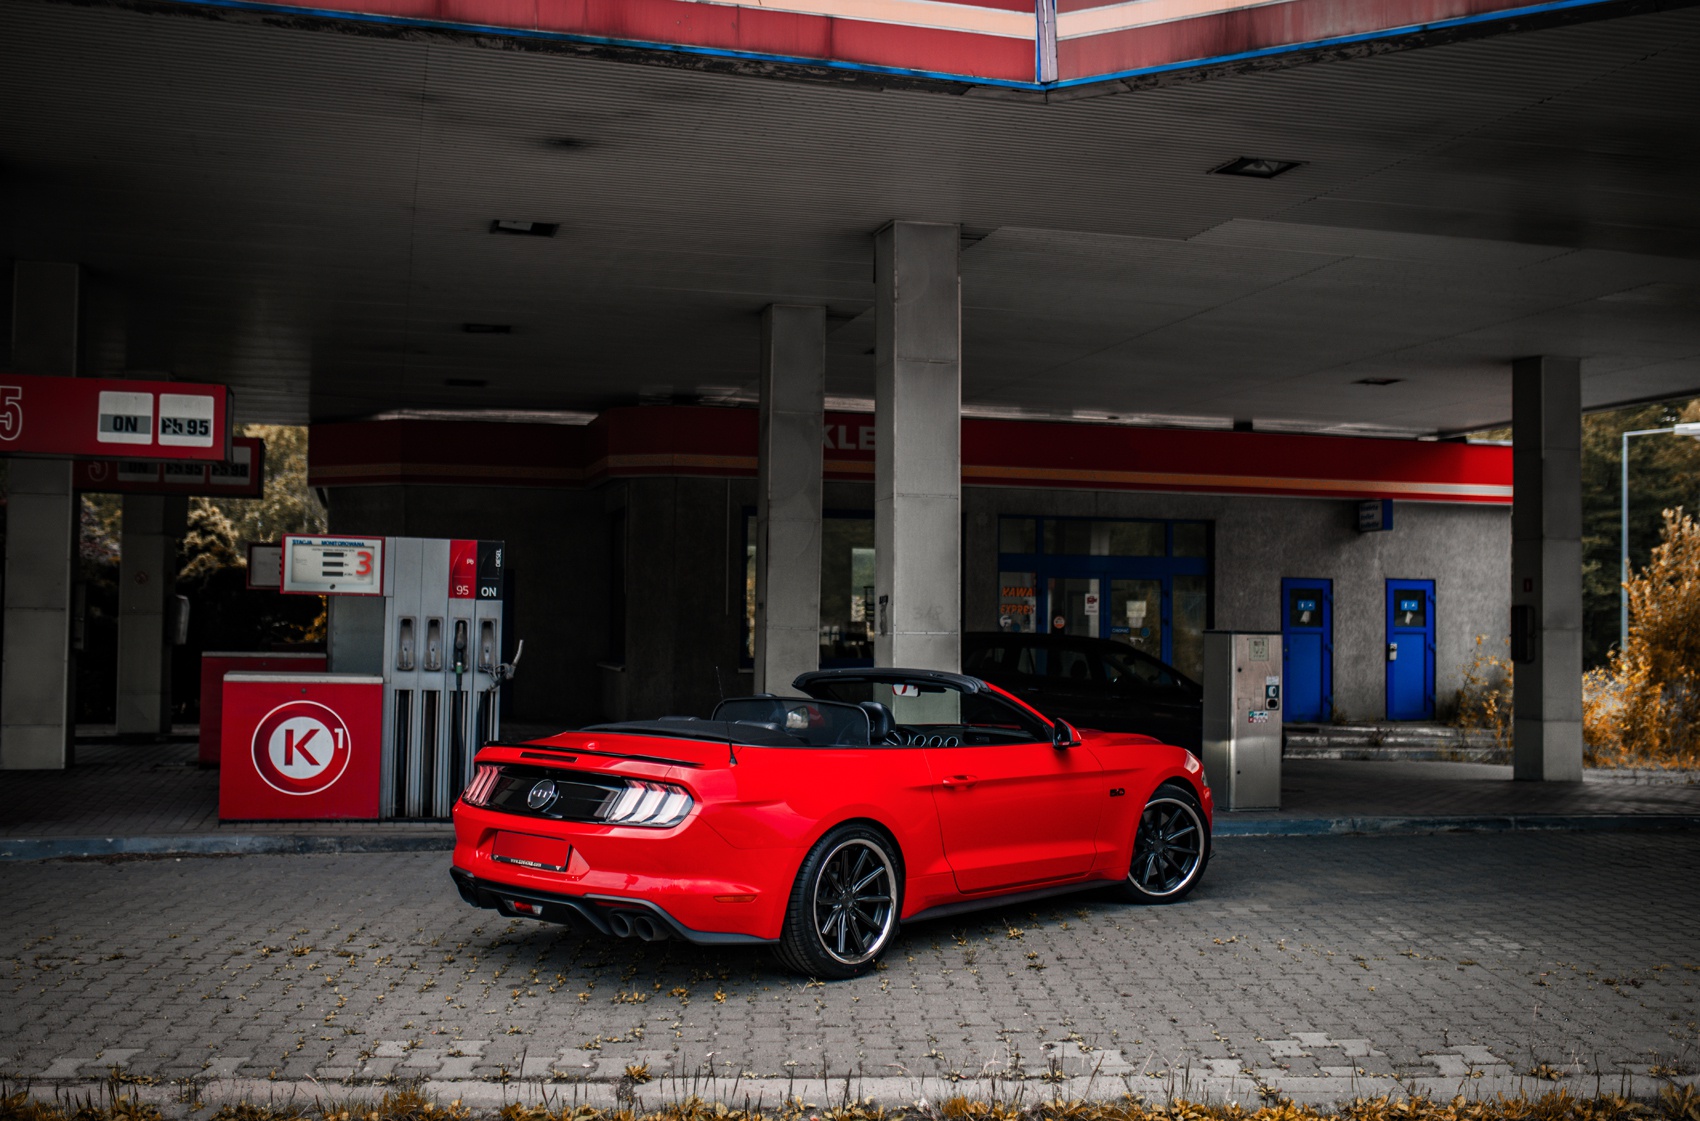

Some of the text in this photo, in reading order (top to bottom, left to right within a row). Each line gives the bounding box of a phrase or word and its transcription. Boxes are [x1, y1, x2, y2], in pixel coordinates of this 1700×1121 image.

[0, 385, 23, 441] 5
[112, 416, 138, 432] ON
[187, 419, 209, 435] 95
[356, 550, 373, 575] 3
[456, 585, 470, 595] 95
[481, 586, 497, 597] ON
[1001, 586, 1034, 597] KAWA
